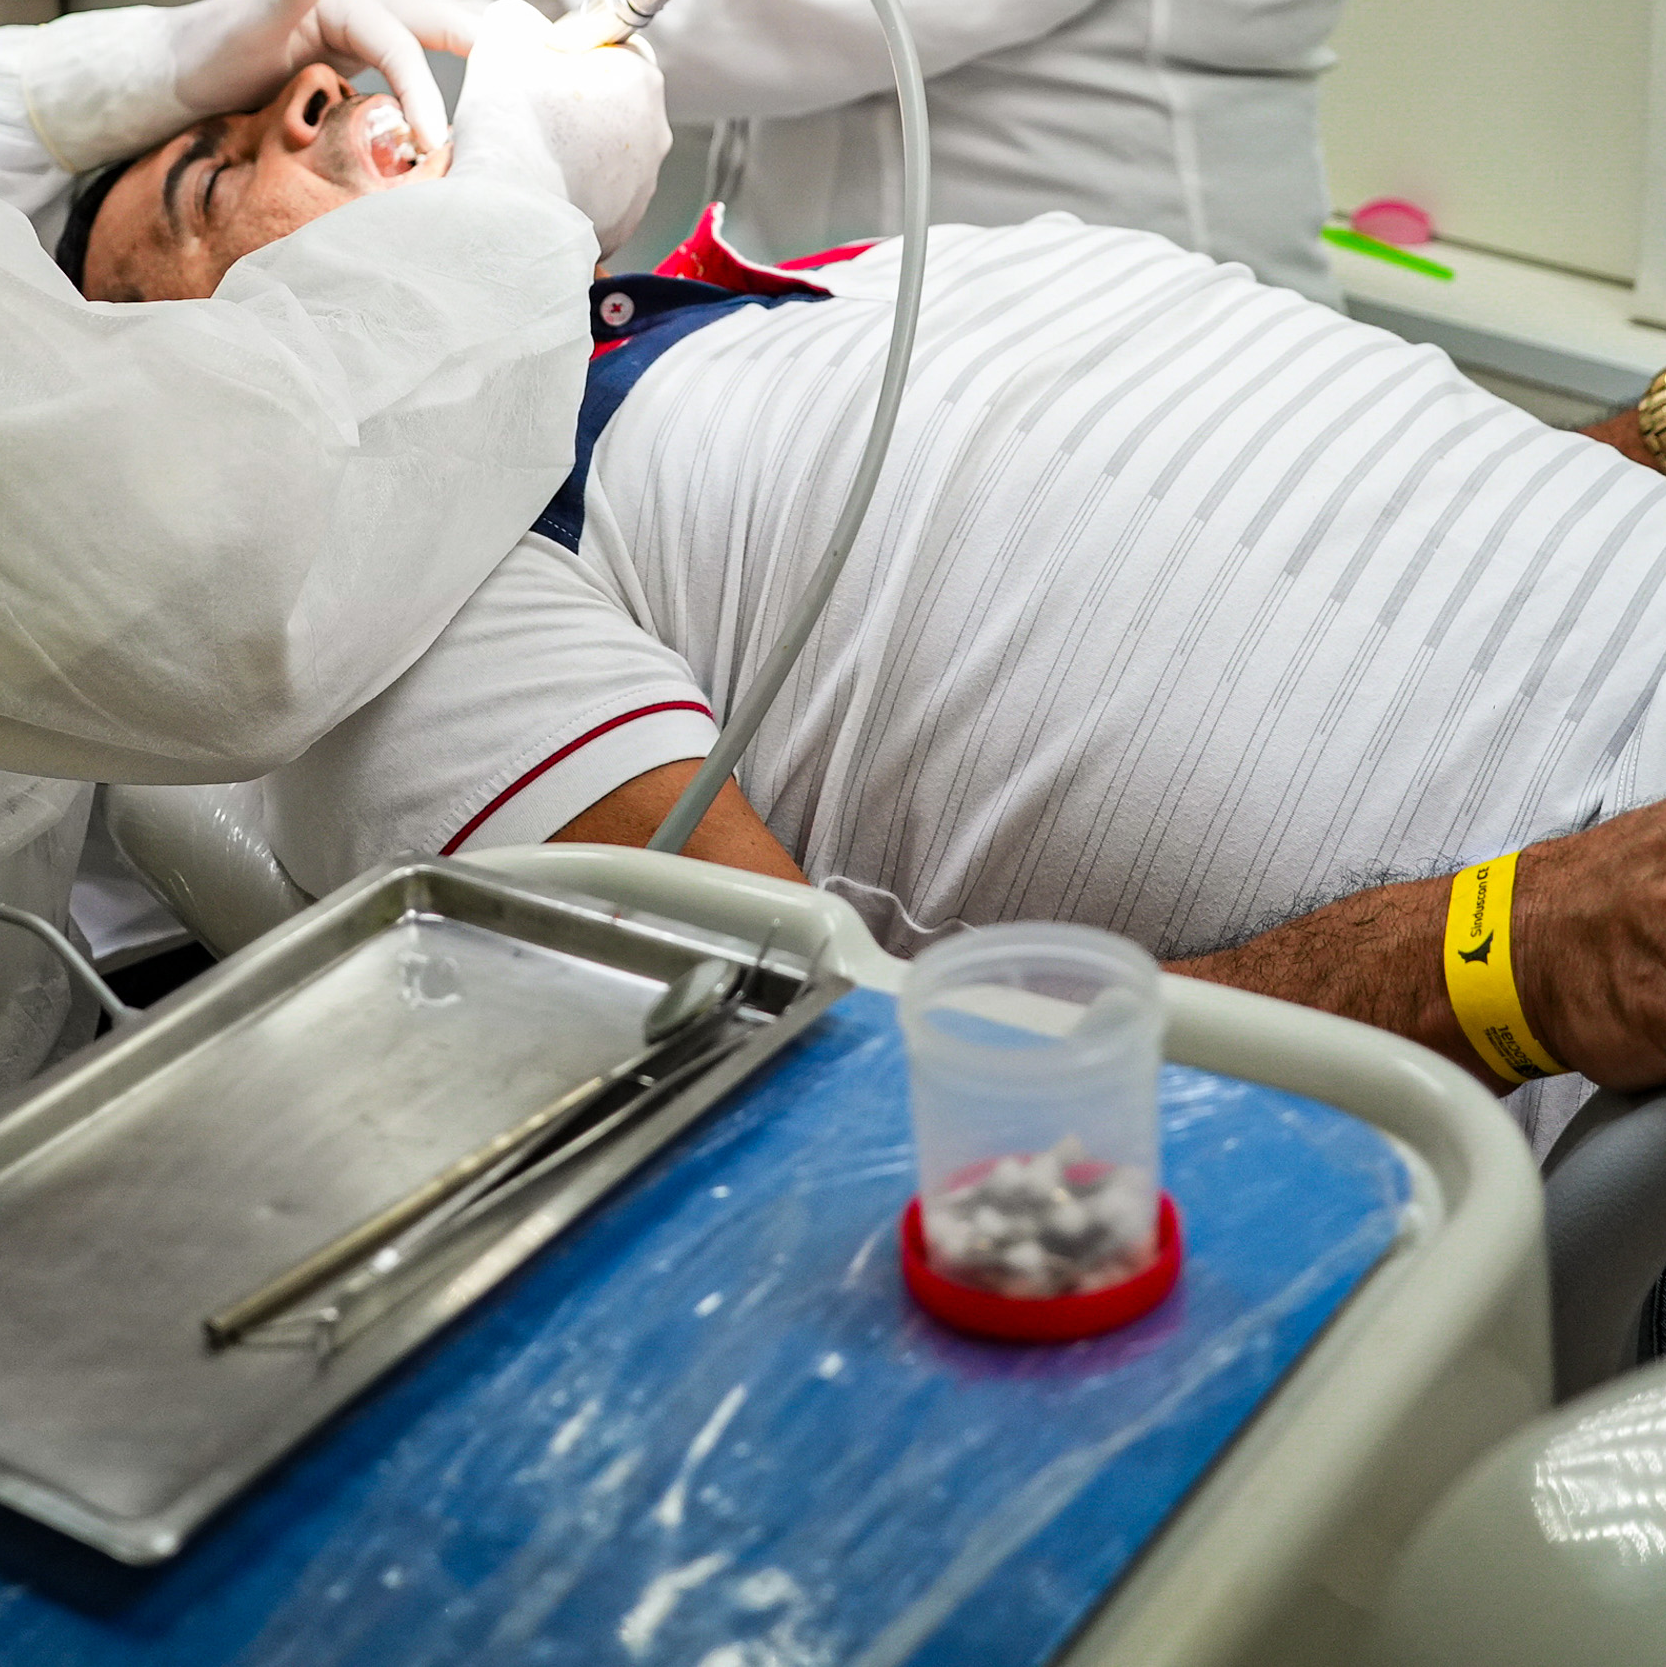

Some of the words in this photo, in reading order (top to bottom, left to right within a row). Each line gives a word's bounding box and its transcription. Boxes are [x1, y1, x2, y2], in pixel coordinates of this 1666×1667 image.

[1476, 866, 1491, 882] CE
[1470, 881, 1487, 938] Sinduscon
[1498, 1024, 1533, 1064] social
